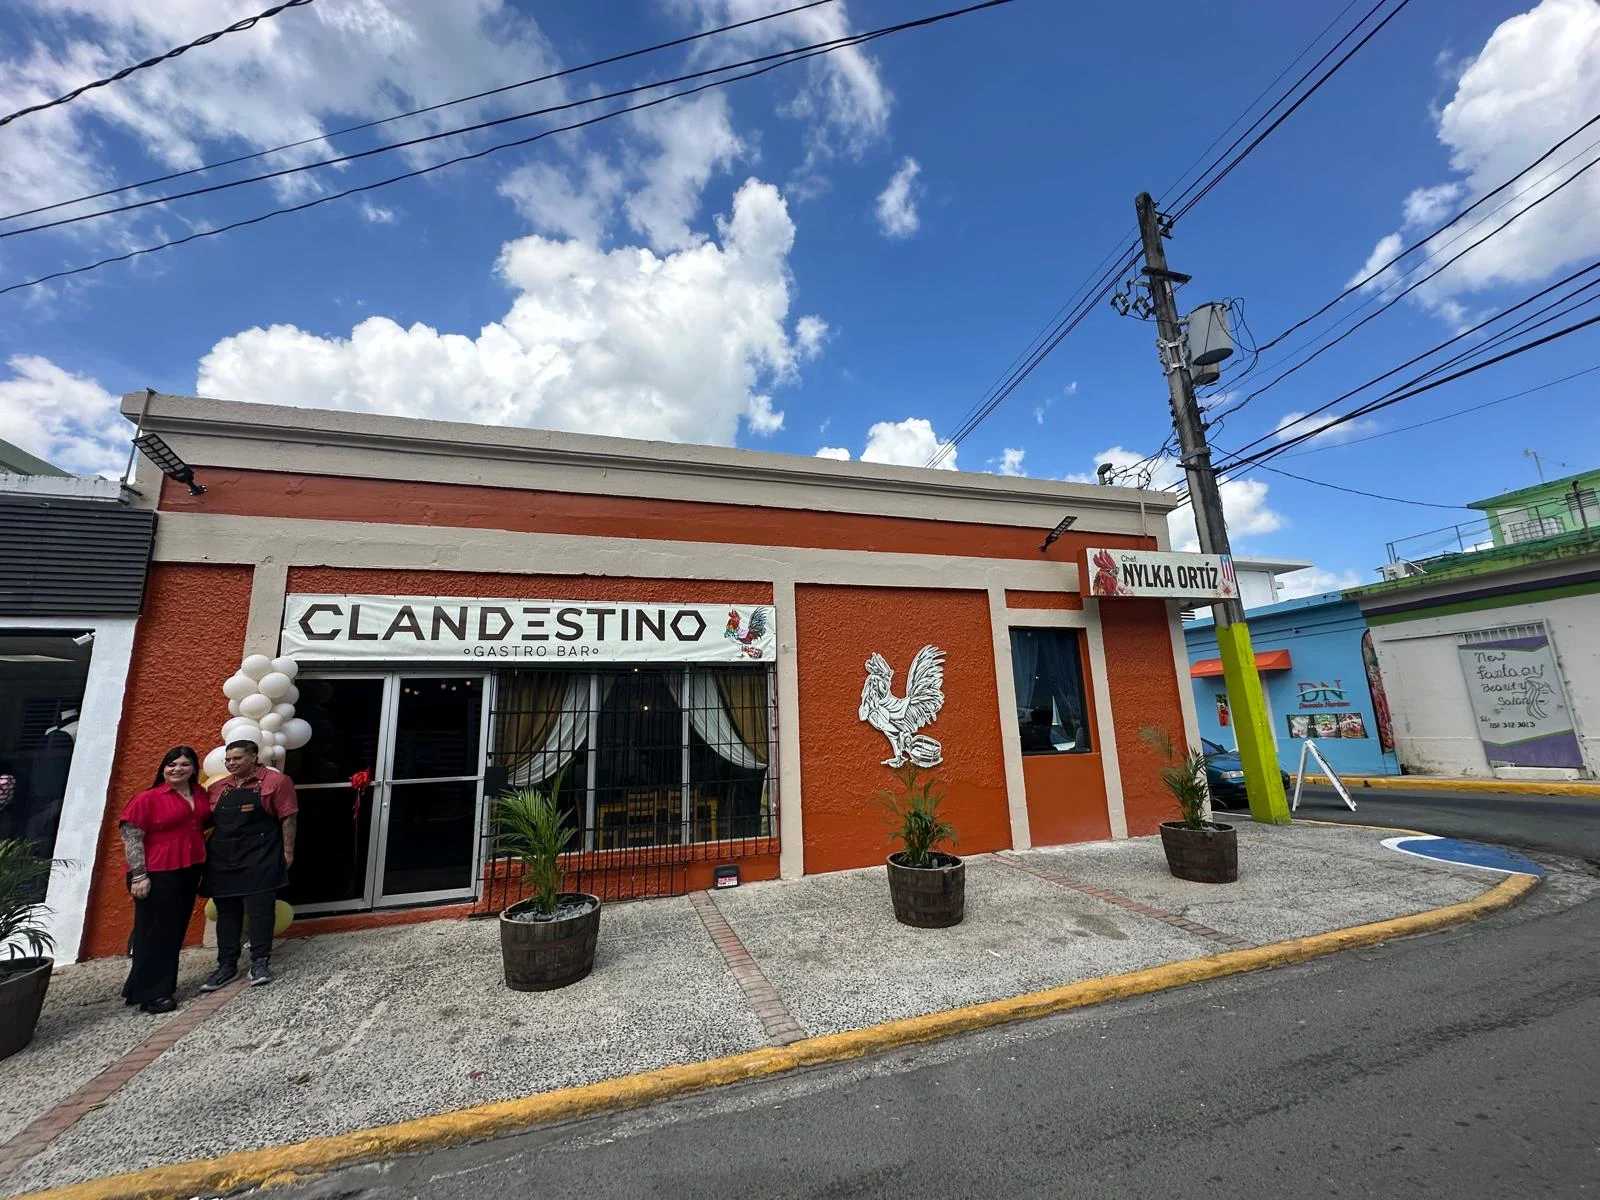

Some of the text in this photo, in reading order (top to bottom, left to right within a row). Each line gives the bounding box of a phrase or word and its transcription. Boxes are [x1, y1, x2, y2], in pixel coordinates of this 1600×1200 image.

[1123, 562, 1218, 589] NYLKA ORTÍZ
[298, 603, 707, 642] CLANDESTINO
[474, 645, 591, 658] GASTRO BAR
[1297, 680, 1344, 702] DN
